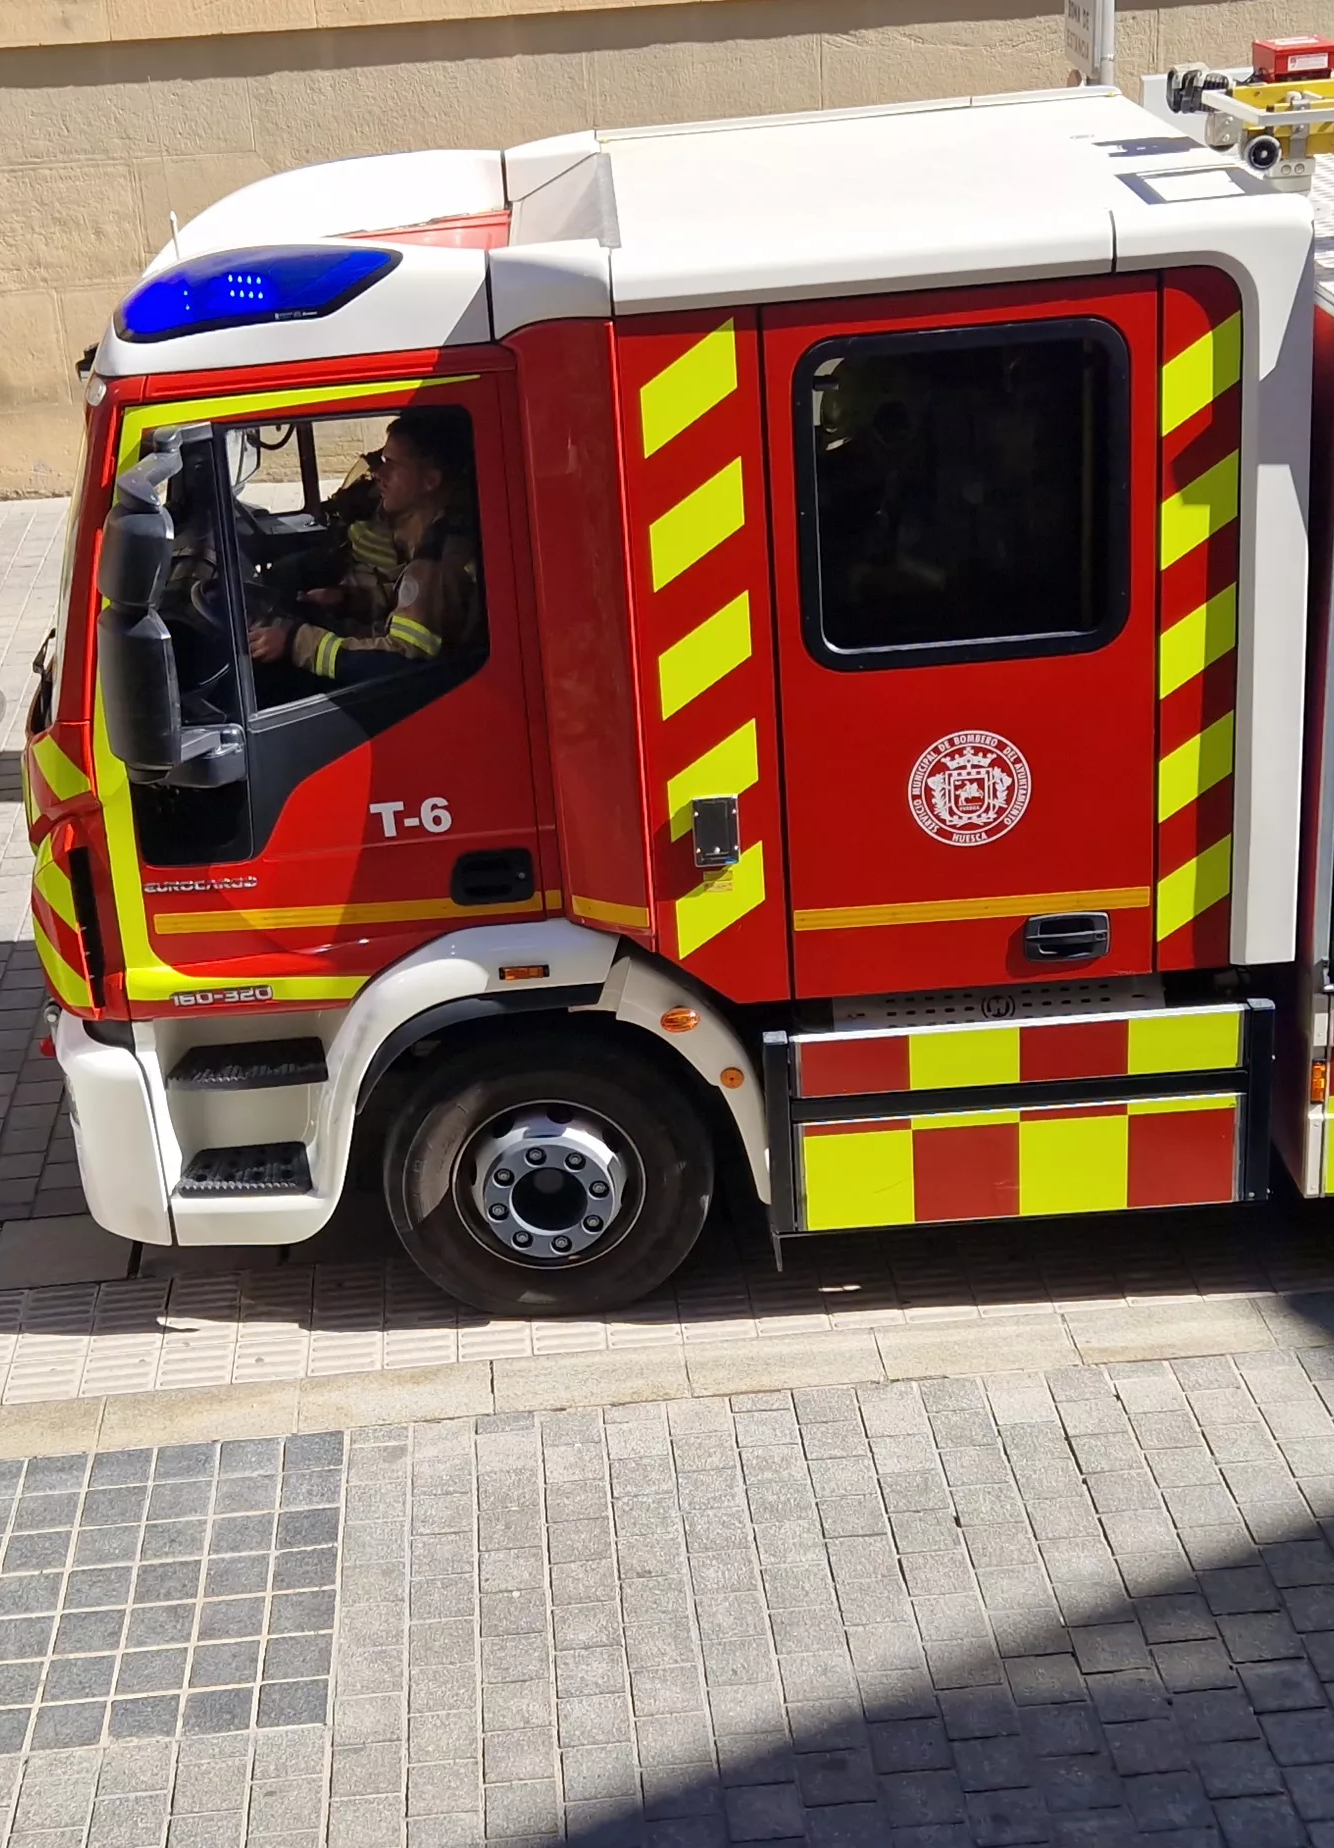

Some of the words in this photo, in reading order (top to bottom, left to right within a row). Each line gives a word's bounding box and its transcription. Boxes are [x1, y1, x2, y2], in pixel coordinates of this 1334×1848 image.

[937, 742, 951, 752] DE
[1003, 747, 1017, 762] DEL
[912, 750, 938, 795] MUNICIPAL
[1003, 763, 1028, 826] AYUNTAMIENTO
[370, 796, 452, 838] T-6
[913, 799, 940, 833] SERVICIO
[952, 832, 988, 843] HUESCA
[144, 876, 257, 893] EUROCARGO
[171, 986, 272, 1006] 160-320
